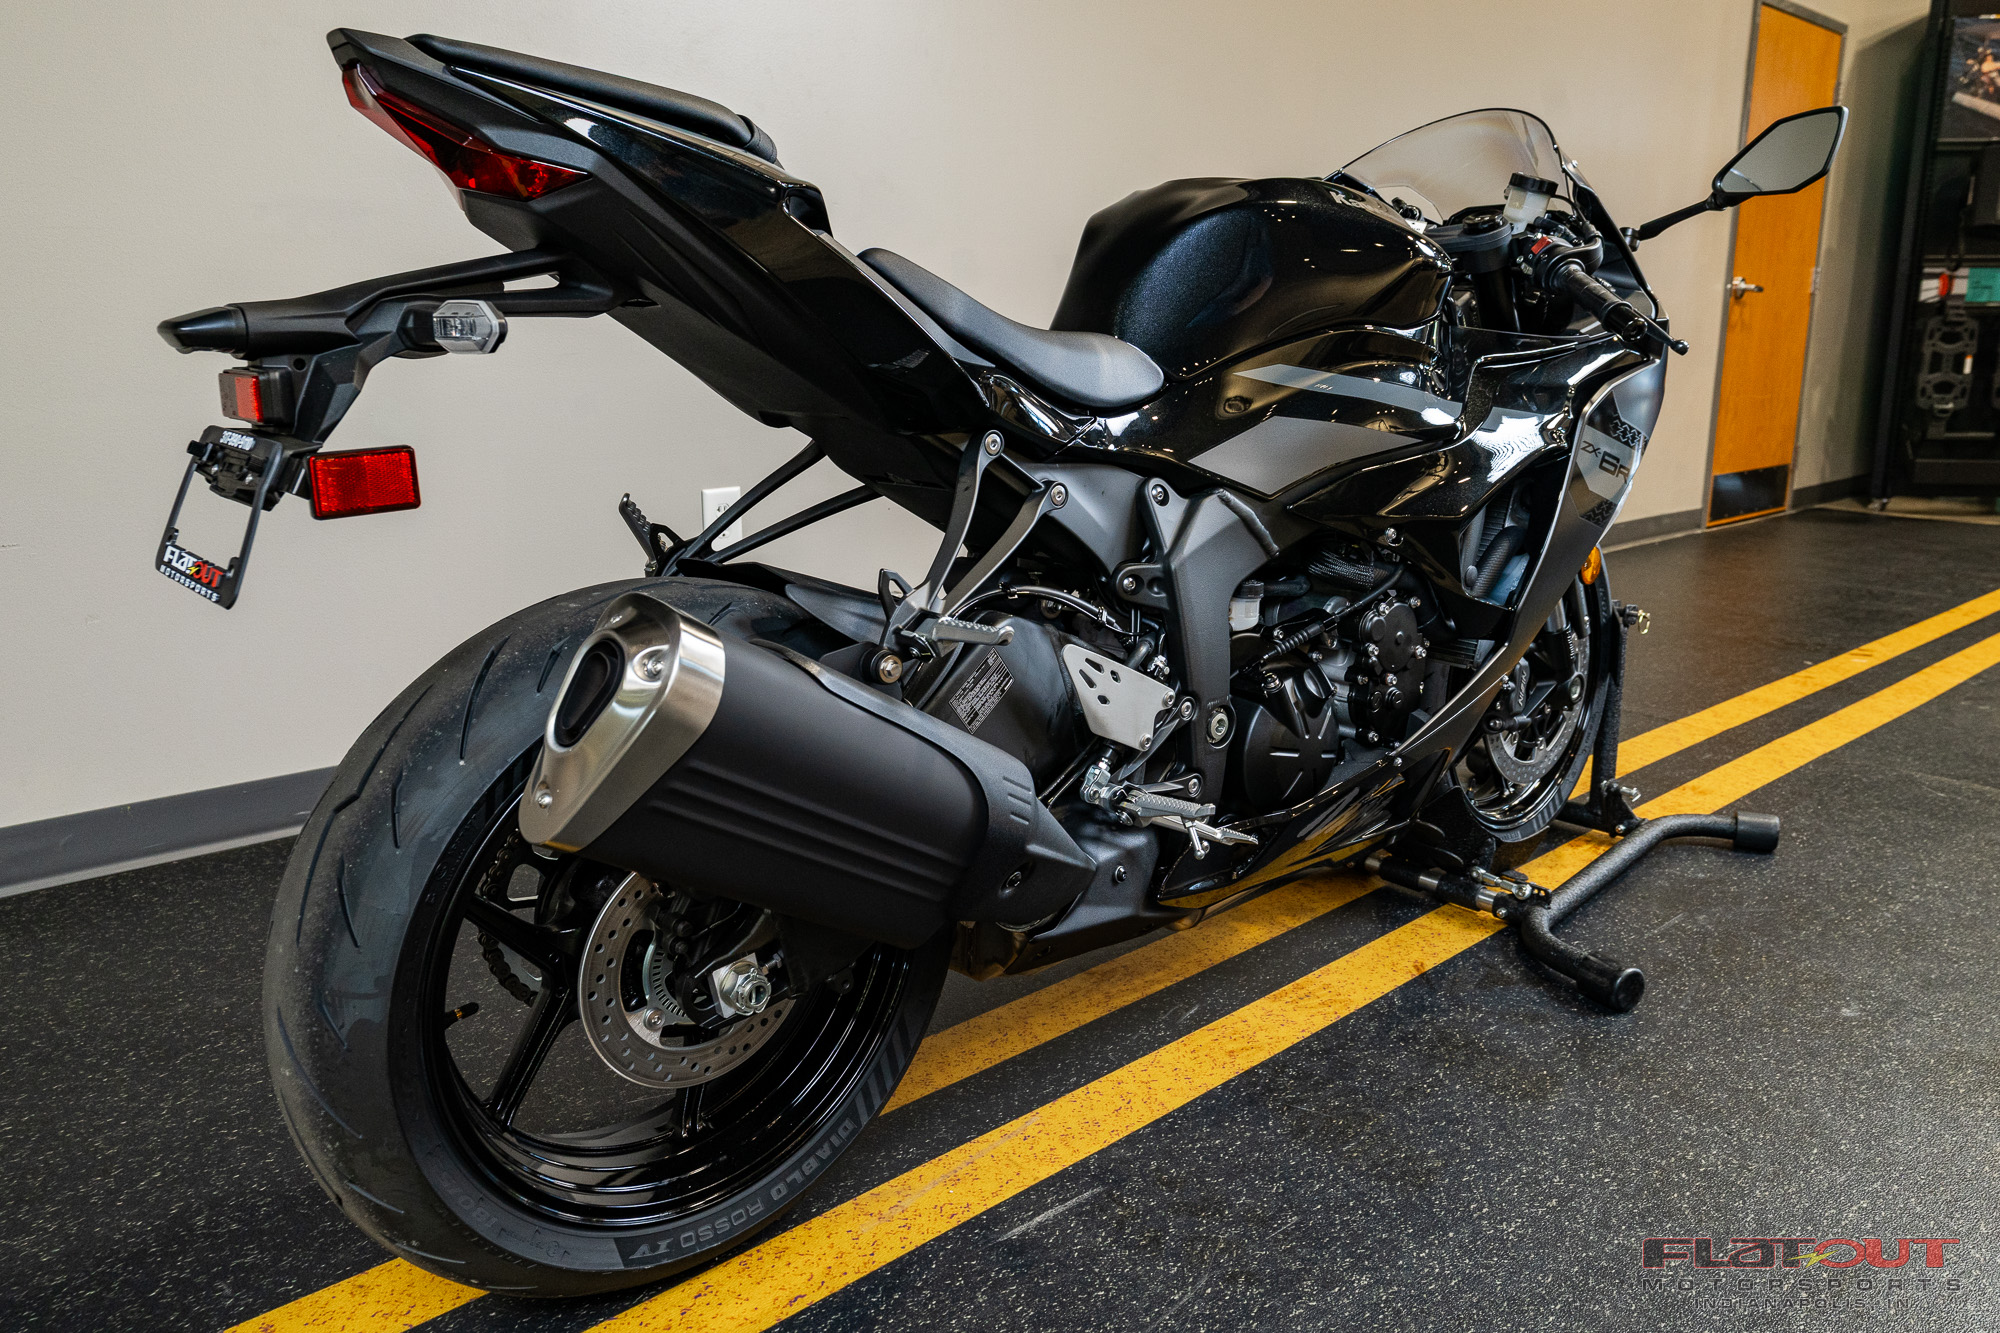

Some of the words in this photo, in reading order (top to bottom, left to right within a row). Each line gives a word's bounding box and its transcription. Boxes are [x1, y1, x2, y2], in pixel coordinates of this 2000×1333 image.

[1580, 440, 1631, 485] ZX-6R
[160, 564, 220, 602] MOTORSPORTS
[770, 1118, 858, 1201] DIABLO
[679, 1198, 765, 1248] ROSSO
[628, 1238, 674, 1260] IV
